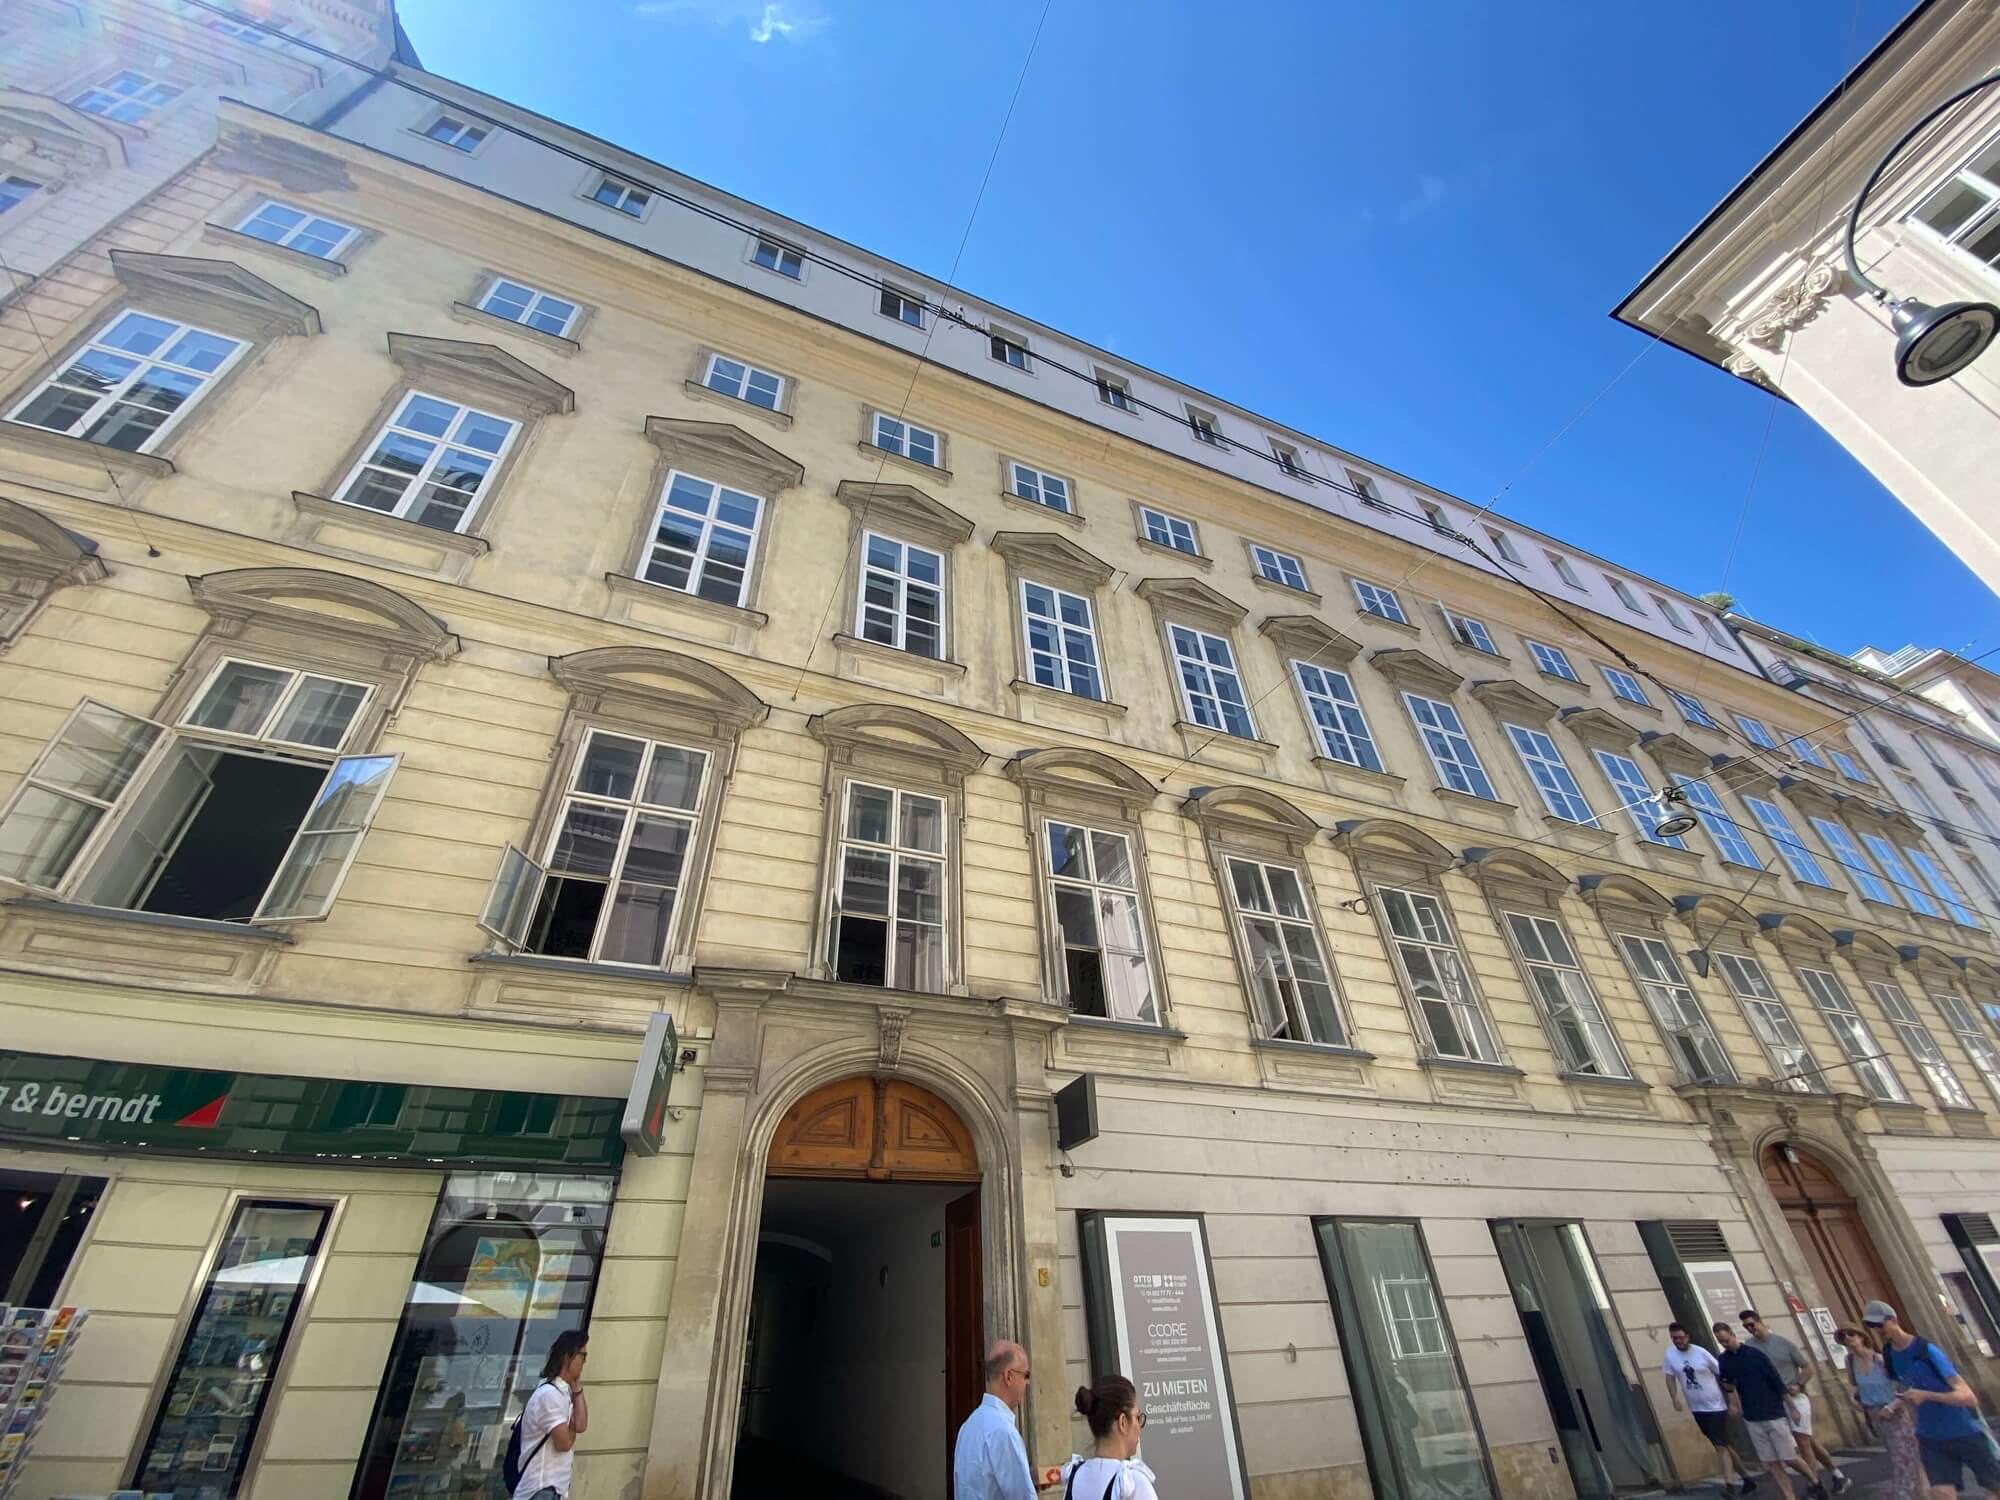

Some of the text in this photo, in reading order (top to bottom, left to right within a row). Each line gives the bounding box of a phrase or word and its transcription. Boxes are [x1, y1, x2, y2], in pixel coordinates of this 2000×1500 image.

[11, 1082, 40, 1113] &
[41, 1085, 162, 1124] berndt
[1133, 1275, 1152, 1283] OTTO
[1147, 1322, 1188, 1337] COORE
[1143, 1378, 1208, 1397] ZU MIETEN
[1145, 1400, 1211, 1414] Geschäftsfläche
